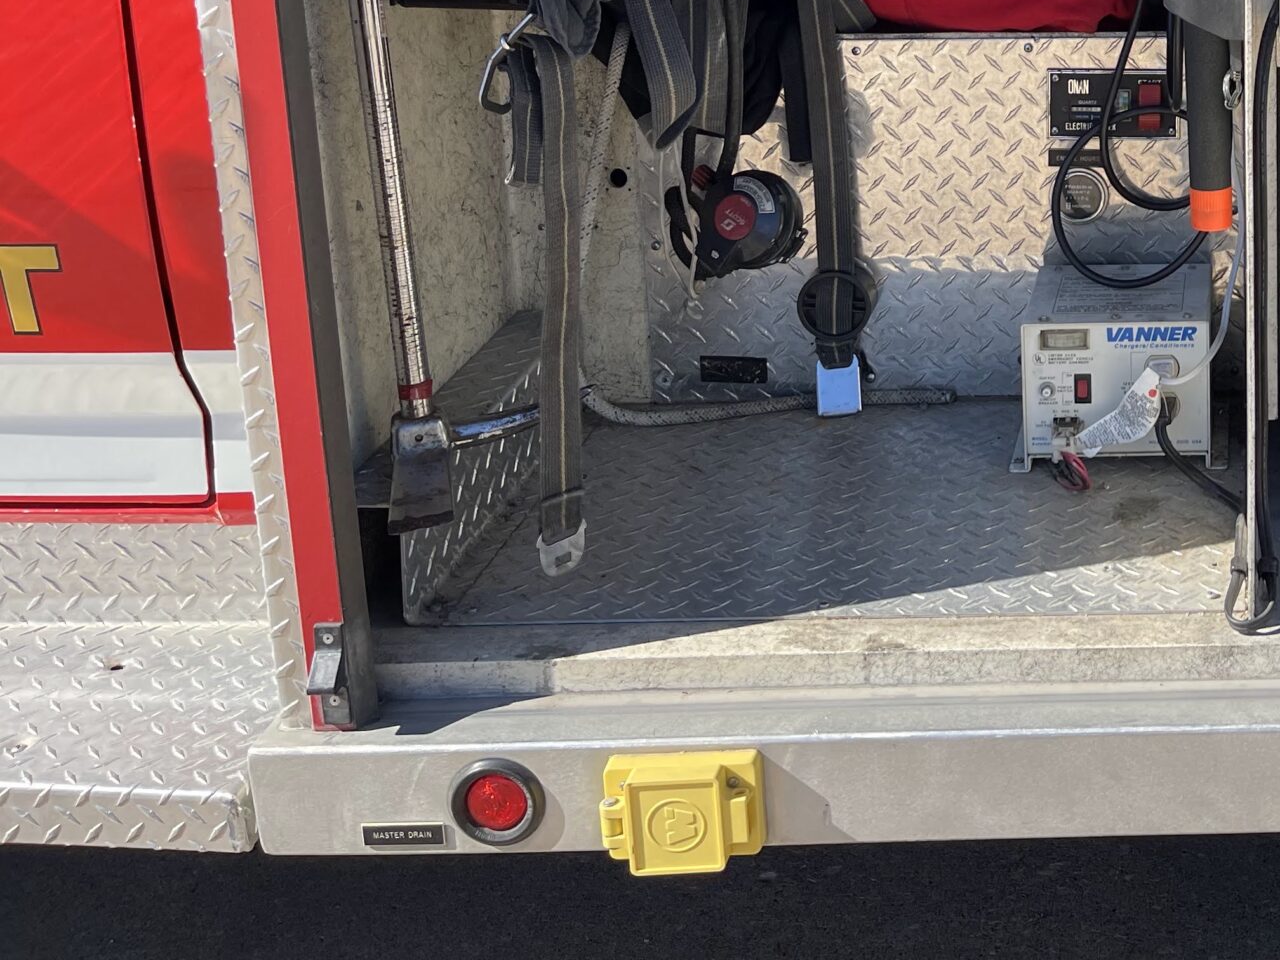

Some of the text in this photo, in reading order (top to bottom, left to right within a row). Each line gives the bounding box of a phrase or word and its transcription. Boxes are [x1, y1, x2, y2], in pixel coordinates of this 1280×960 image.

[1068, 79, 1089, 94] ONAN
[0, 244, 63, 336] T
[1107, 327, 1197, 342] VANNER
